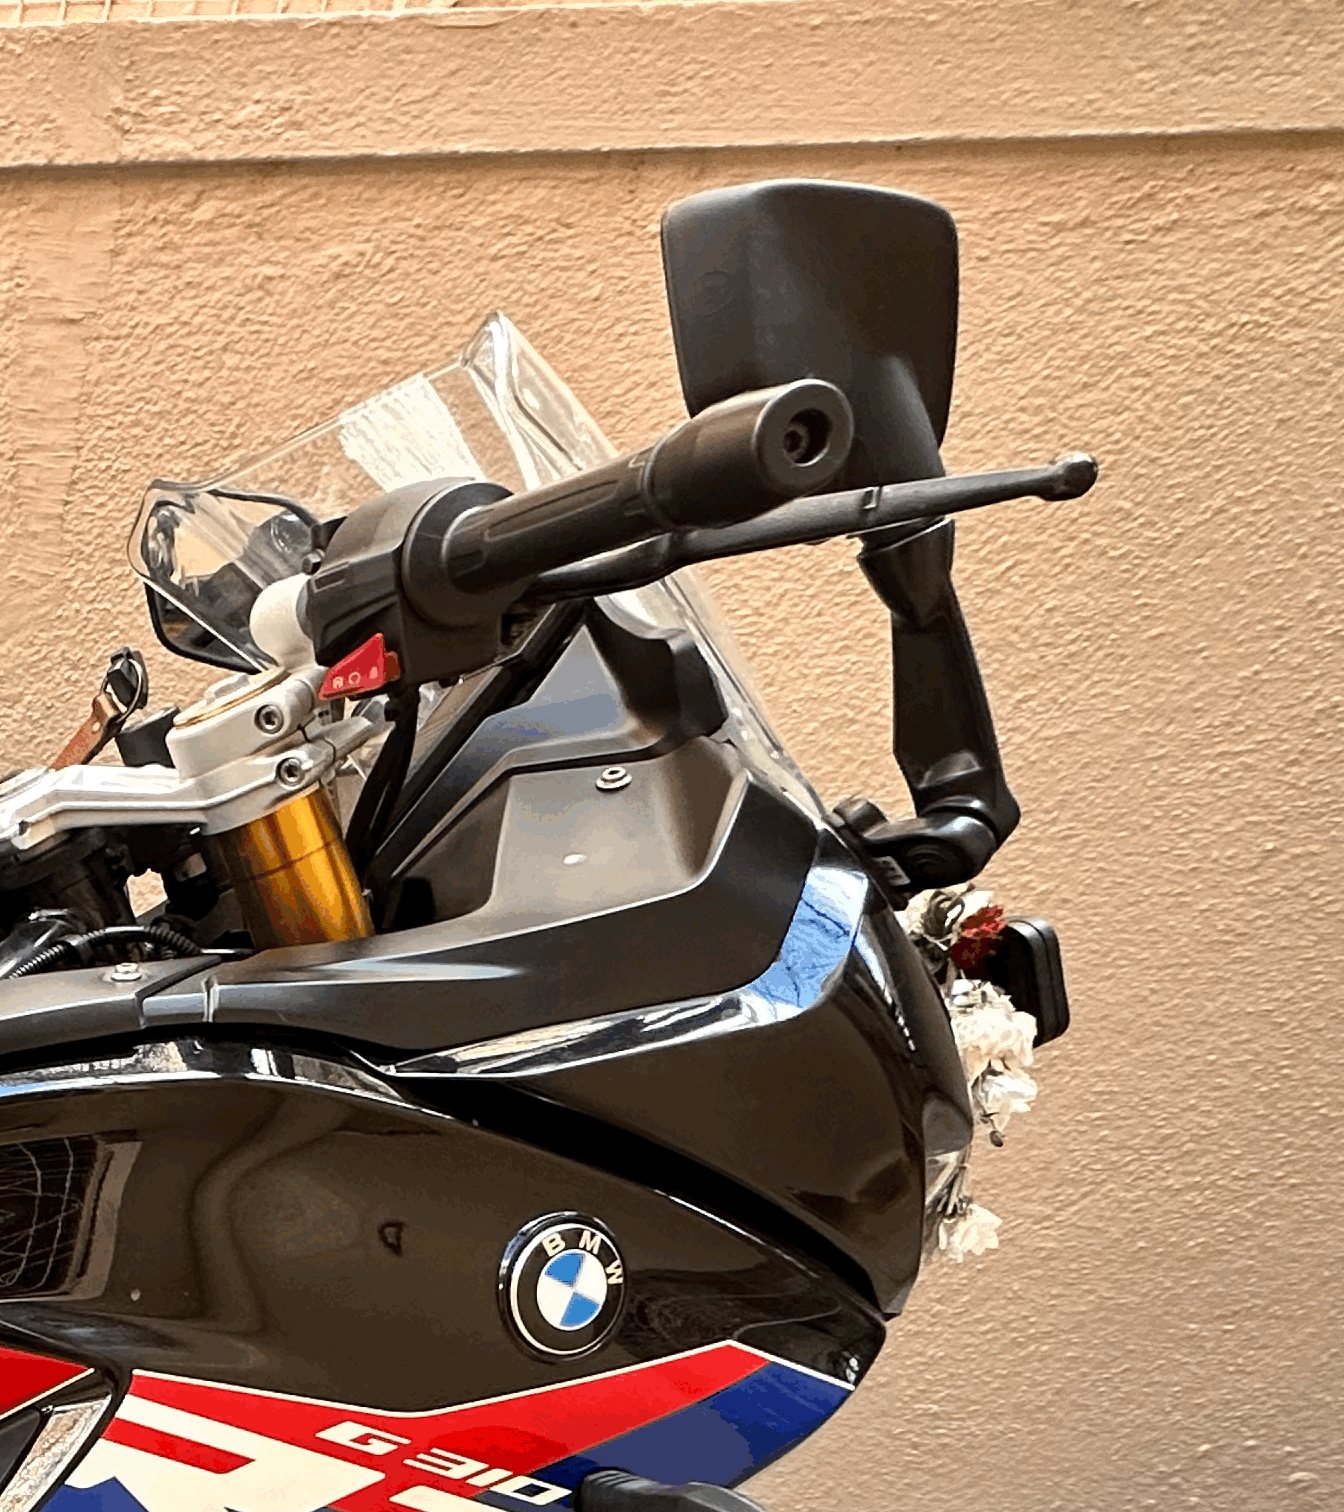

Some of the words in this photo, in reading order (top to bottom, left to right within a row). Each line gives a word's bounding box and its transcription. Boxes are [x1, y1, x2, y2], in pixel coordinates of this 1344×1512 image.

[542, 1230, 624, 1285] BMW
[315, 1420, 412, 1456] G
[403, 1447, 573, 1506] 310
